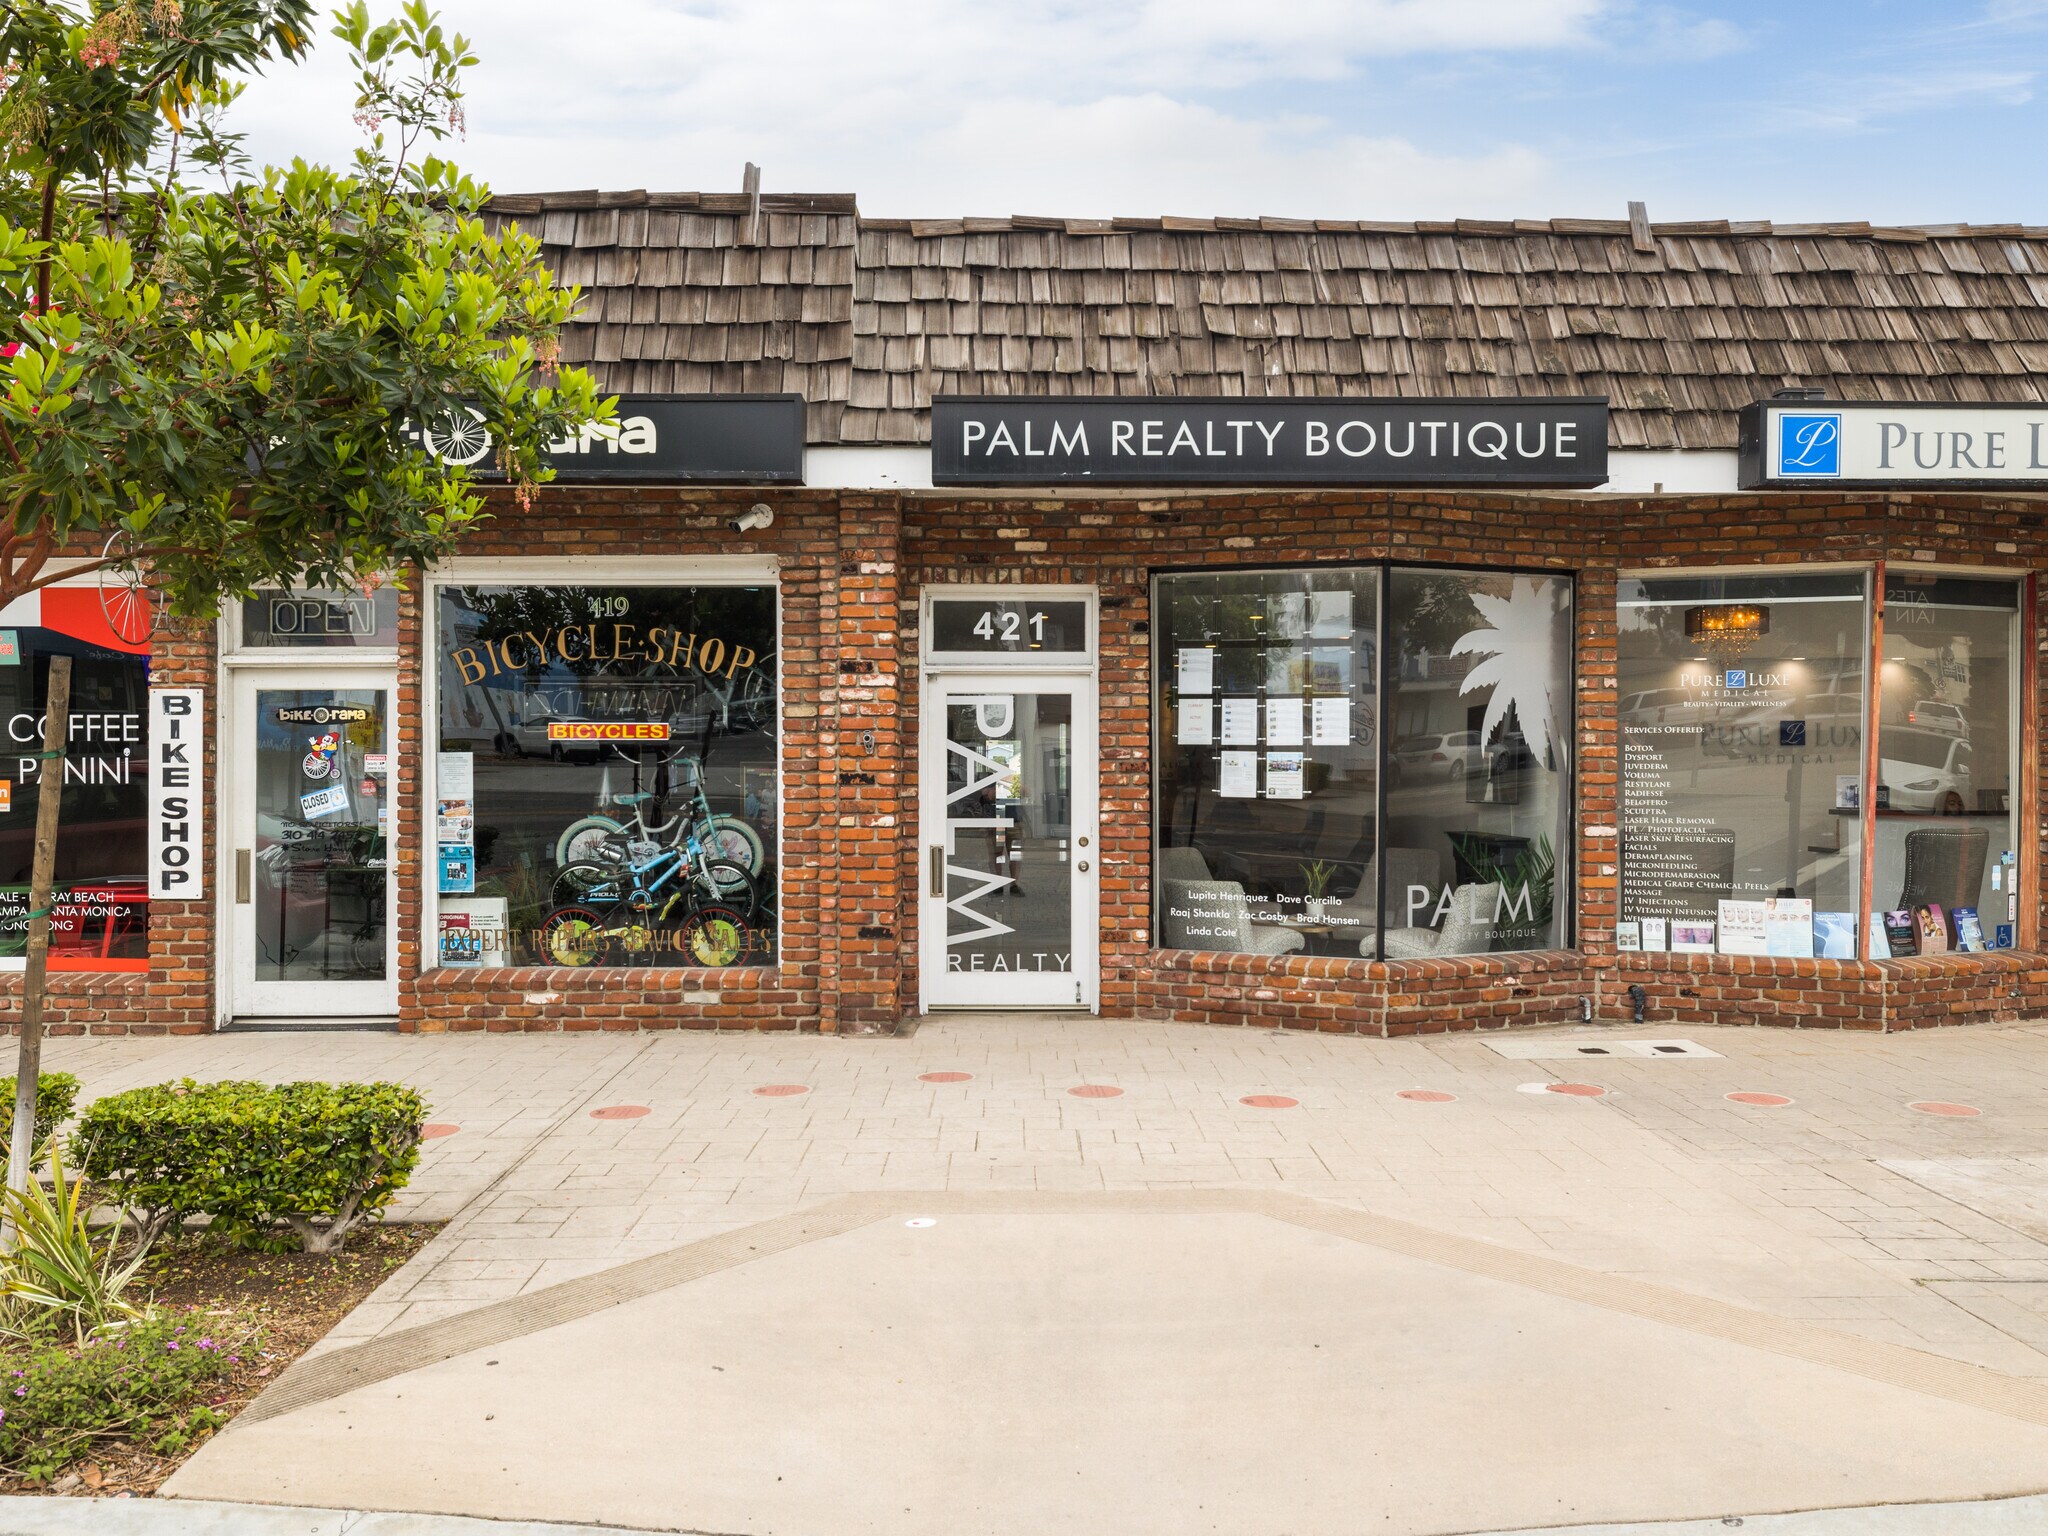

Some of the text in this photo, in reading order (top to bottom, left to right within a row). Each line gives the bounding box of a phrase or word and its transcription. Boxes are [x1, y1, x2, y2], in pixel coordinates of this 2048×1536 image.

[963, 420, 1578, 460] PALM REALTY BOUTIQUE
[1876, 422, 2006, 469] PURE
[590, 597, 630, 617] 419
[276, 602, 370, 633] OPEN
[974, 613, 1044, 641] 421
[452, 624, 756, 686] BICYCLE SHOP
[1680, 673, 1723, 687] PURE
[1748, 673, 1790, 686] LUXE
[8, 714, 140, 742] CFFEE
[553, 725, 664, 738] BICYCLES
[1624, 726, 1705, 734] SERVICES OFFERED:
[161, 695, 192, 788] BIKE
[1748, 754, 1834, 764] MEDICAL
[303, 793, 328, 809] CLOSED
[947, 695, 1016, 946] PALM
[1676, 817, 1717, 825] REMOVAL
[282, 830, 302, 840] 310
[306, 830, 325, 840] 414
[1648, 826, 1707, 834] PHOTOFACIAL
[161, 797, 190, 890] SHOP
[1624, 853, 1693, 861] DERMAPLANING
[1624, 862, 1698, 870] MICRONEEDLING
[1624, 870, 1720, 879] MICRODERMABRASION
[1664, 880, 1695, 888] GRADE
[1744, 882, 1769, 890] PEELS
[75, 892, 114, 903] BEACH
[1188, 890, 1268, 903] Lupita Henriquez
[1624, 888, 1663, 896] MASSAGE
[1276, 894, 1342, 906] Dave Curcillo
[1407, 879, 1534, 928] PALM
[1638, 898, 1689, 906] INJECTIONS
[81, 907, 131, 917] MONICA
[1170, 907, 1230, 919] Raaj Shankla
[1635, 906, 1673, 914] VITAMIN
[1239, 911, 1288, 922] Zac Cosby
[1297, 914, 1360, 926] Brad Hansen
[1186, 926, 1212, 936] Linda
[1484, 928, 1537, 939] BOUTIQUE
[444, 928, 773, 952] EXPERT REPAIRS SERVICE SALES
[948, 953, 1072, 972] REALTY
